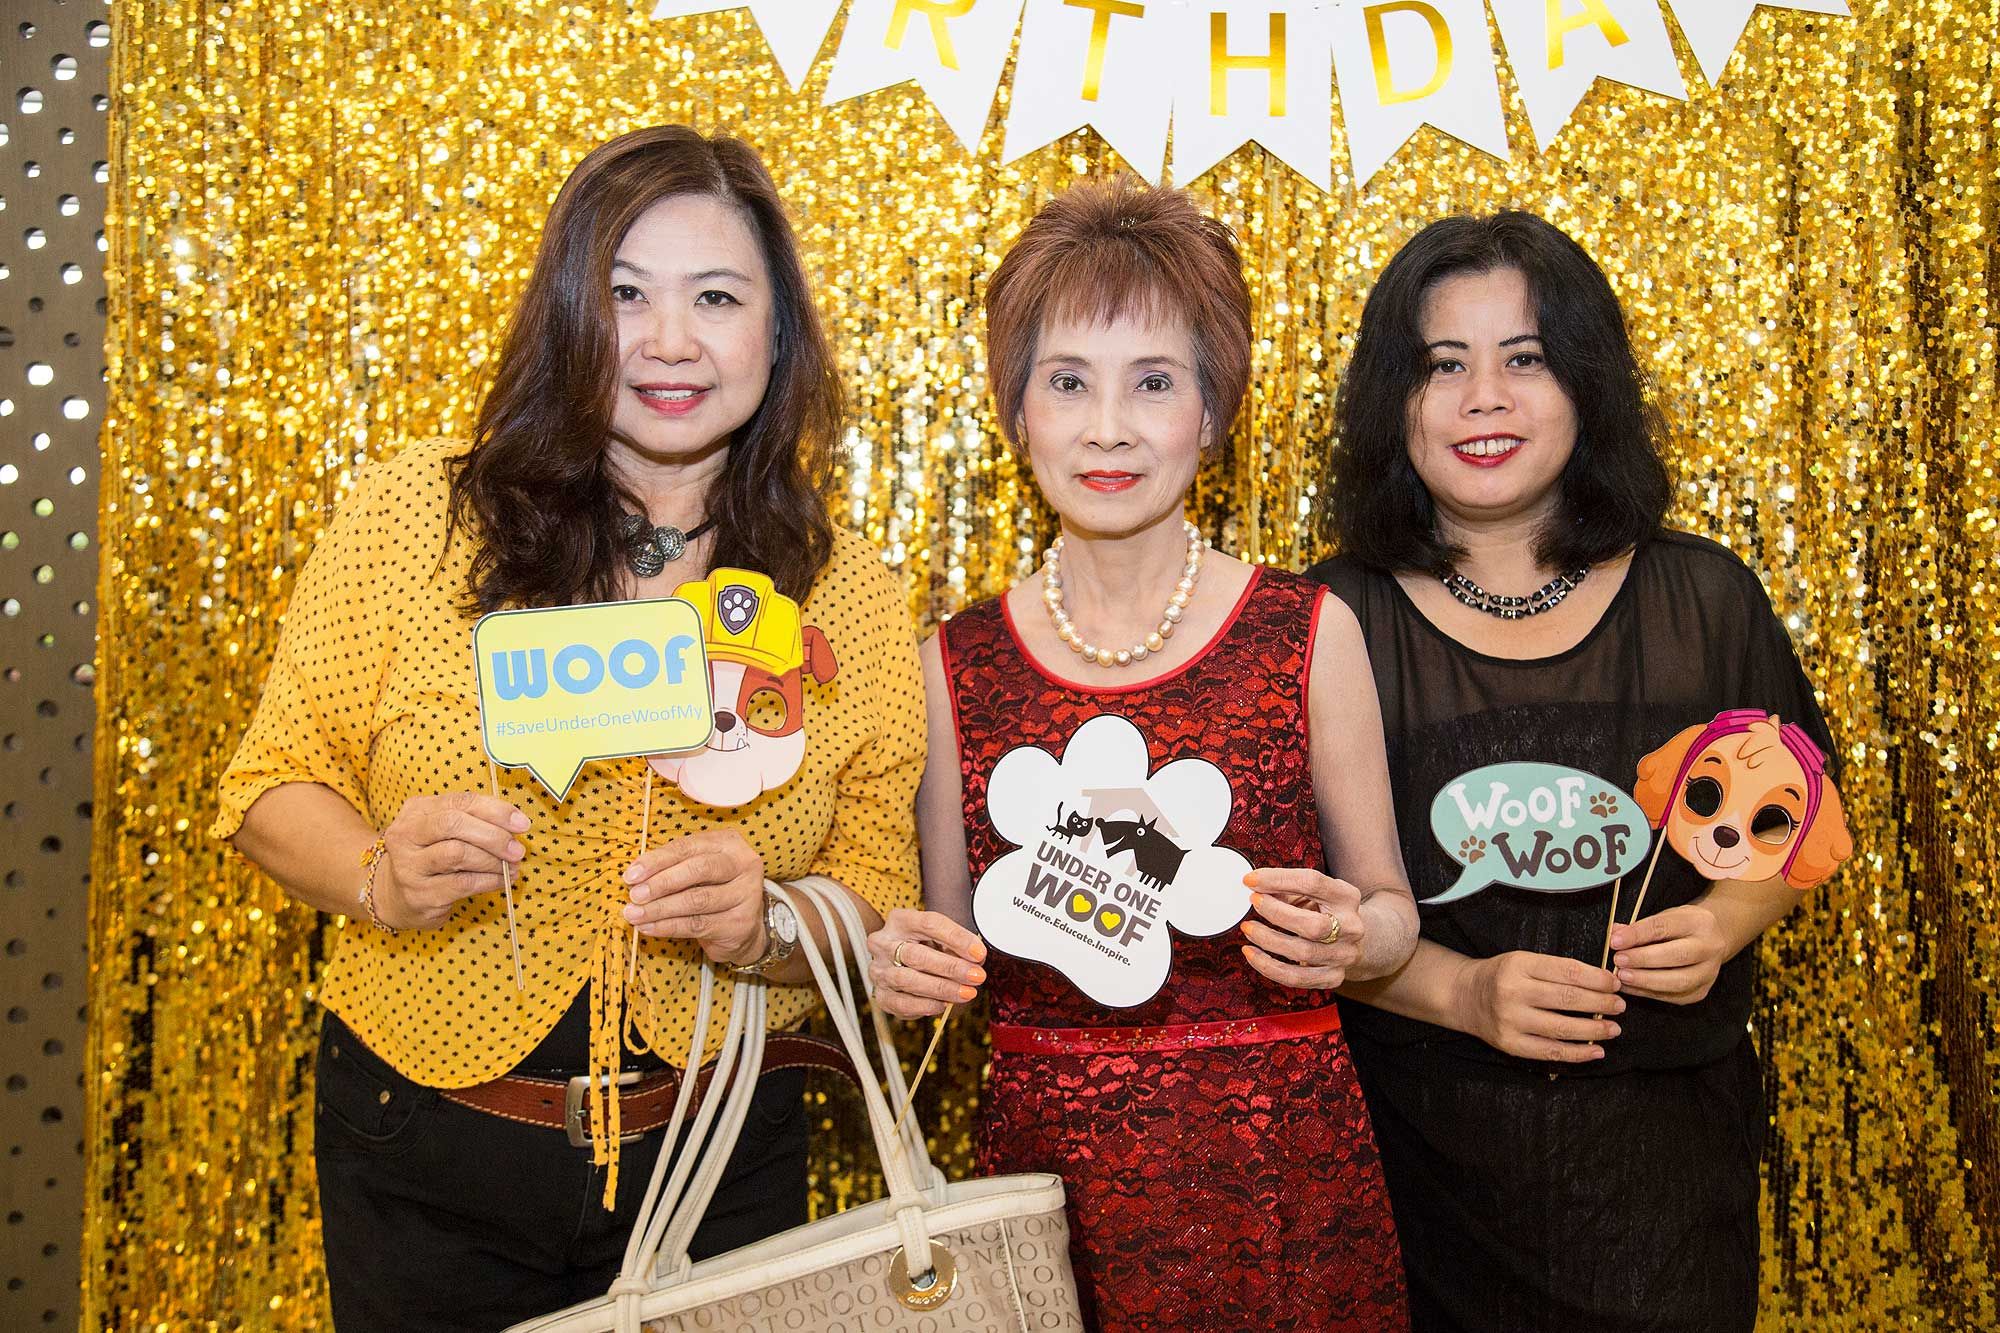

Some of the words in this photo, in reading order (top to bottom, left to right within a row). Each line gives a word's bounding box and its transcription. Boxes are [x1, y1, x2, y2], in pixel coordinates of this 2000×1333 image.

[495, 704, 704, 737] #SaveUnderOneWoofMy
[1023, 862, 1152, 948] WOOF
[1036, 841, 1112, 895] UNDER
[1113, 882, 1162, 919] ONE
